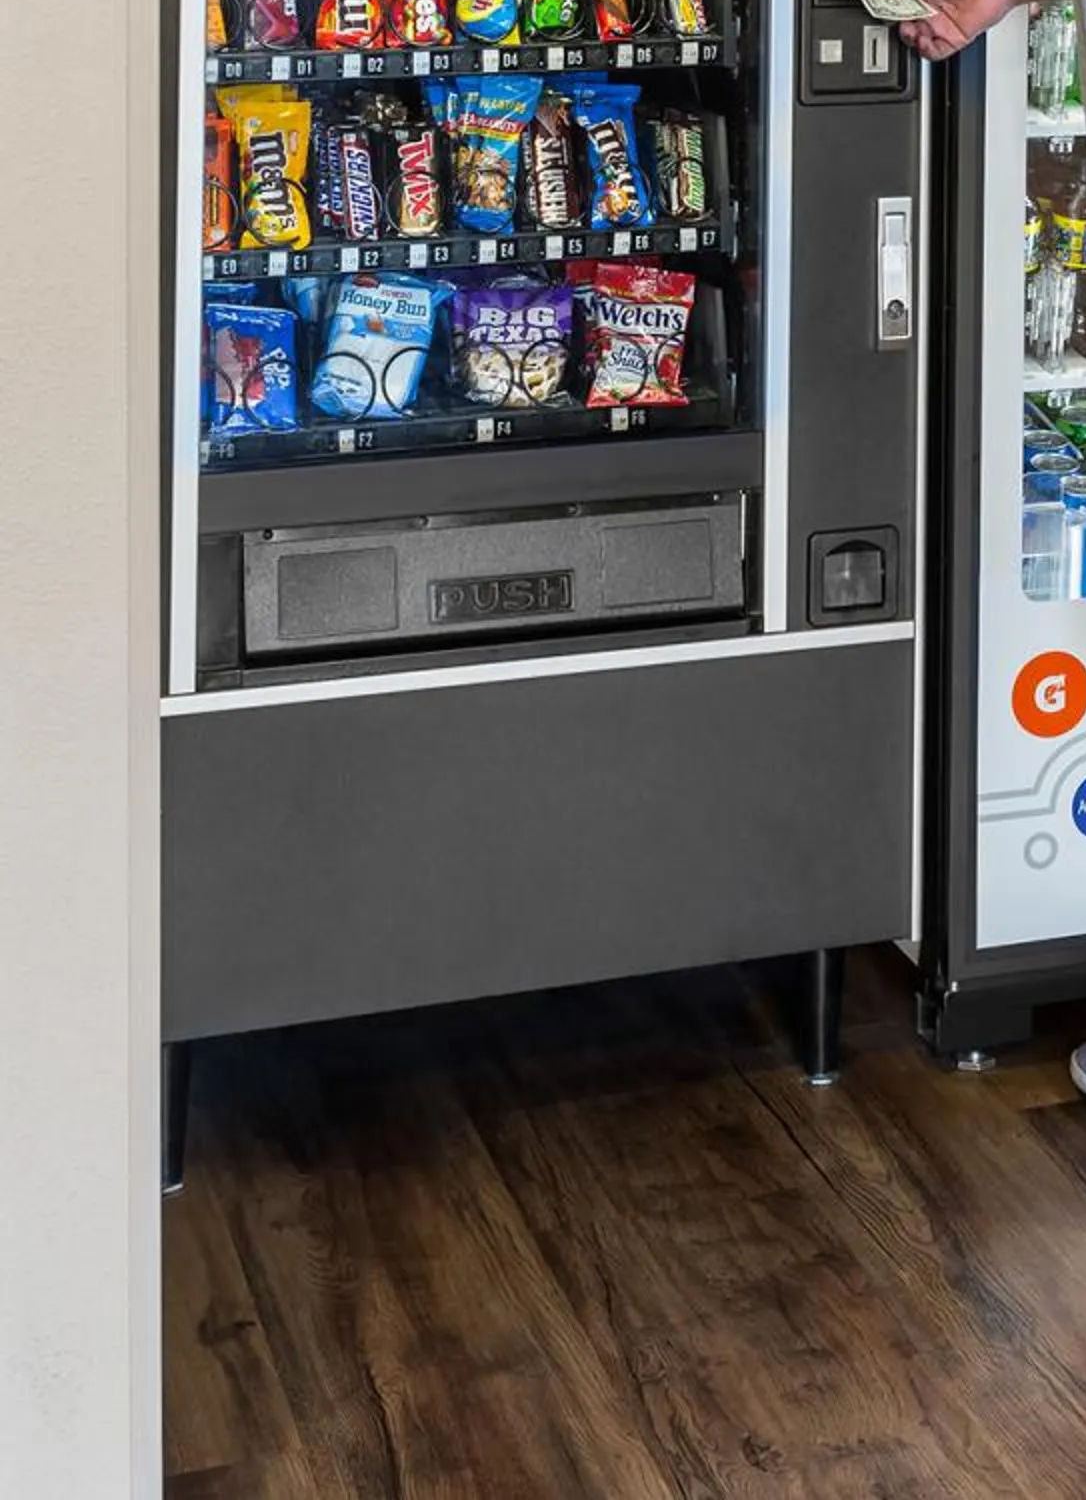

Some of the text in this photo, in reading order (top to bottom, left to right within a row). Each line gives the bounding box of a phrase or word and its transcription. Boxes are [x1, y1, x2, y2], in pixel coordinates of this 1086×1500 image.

[503, 51, 518, 68] D4
[567, 48, 583, 65] D5
[637, 47, 652, 63] D6
[703, 44, 718, 60] D7
[225, 61, 242, 77] D0
[297, 58, 312, 75] D1
[367, 56, 384, 73] D2
[433, 54, 449, 70] D3
[568, 238, 583, 254] E5
[635, 233, 649, 249] E6
[703, 230, 716, 246] E7
[434, 246, 449, 262] E3
[501, 242, 515, 258] E4
[221, 258, 236, 274] E0
[293, 255, 307, 270] E1
[364, 251, 379, 267] E2
[341, 289, 427, 317] Honey Bun
[478, 306, 557, 327] BIG
[600, 300, 684, 332] Welch's
[469, 325, 561, 344] TEXAS
[497, 420, 512, 437] F4
[358, 431, 373, 447] F2
[438, 575, 572, 618] PUSH
[1034, 674, 1067, 714] G
